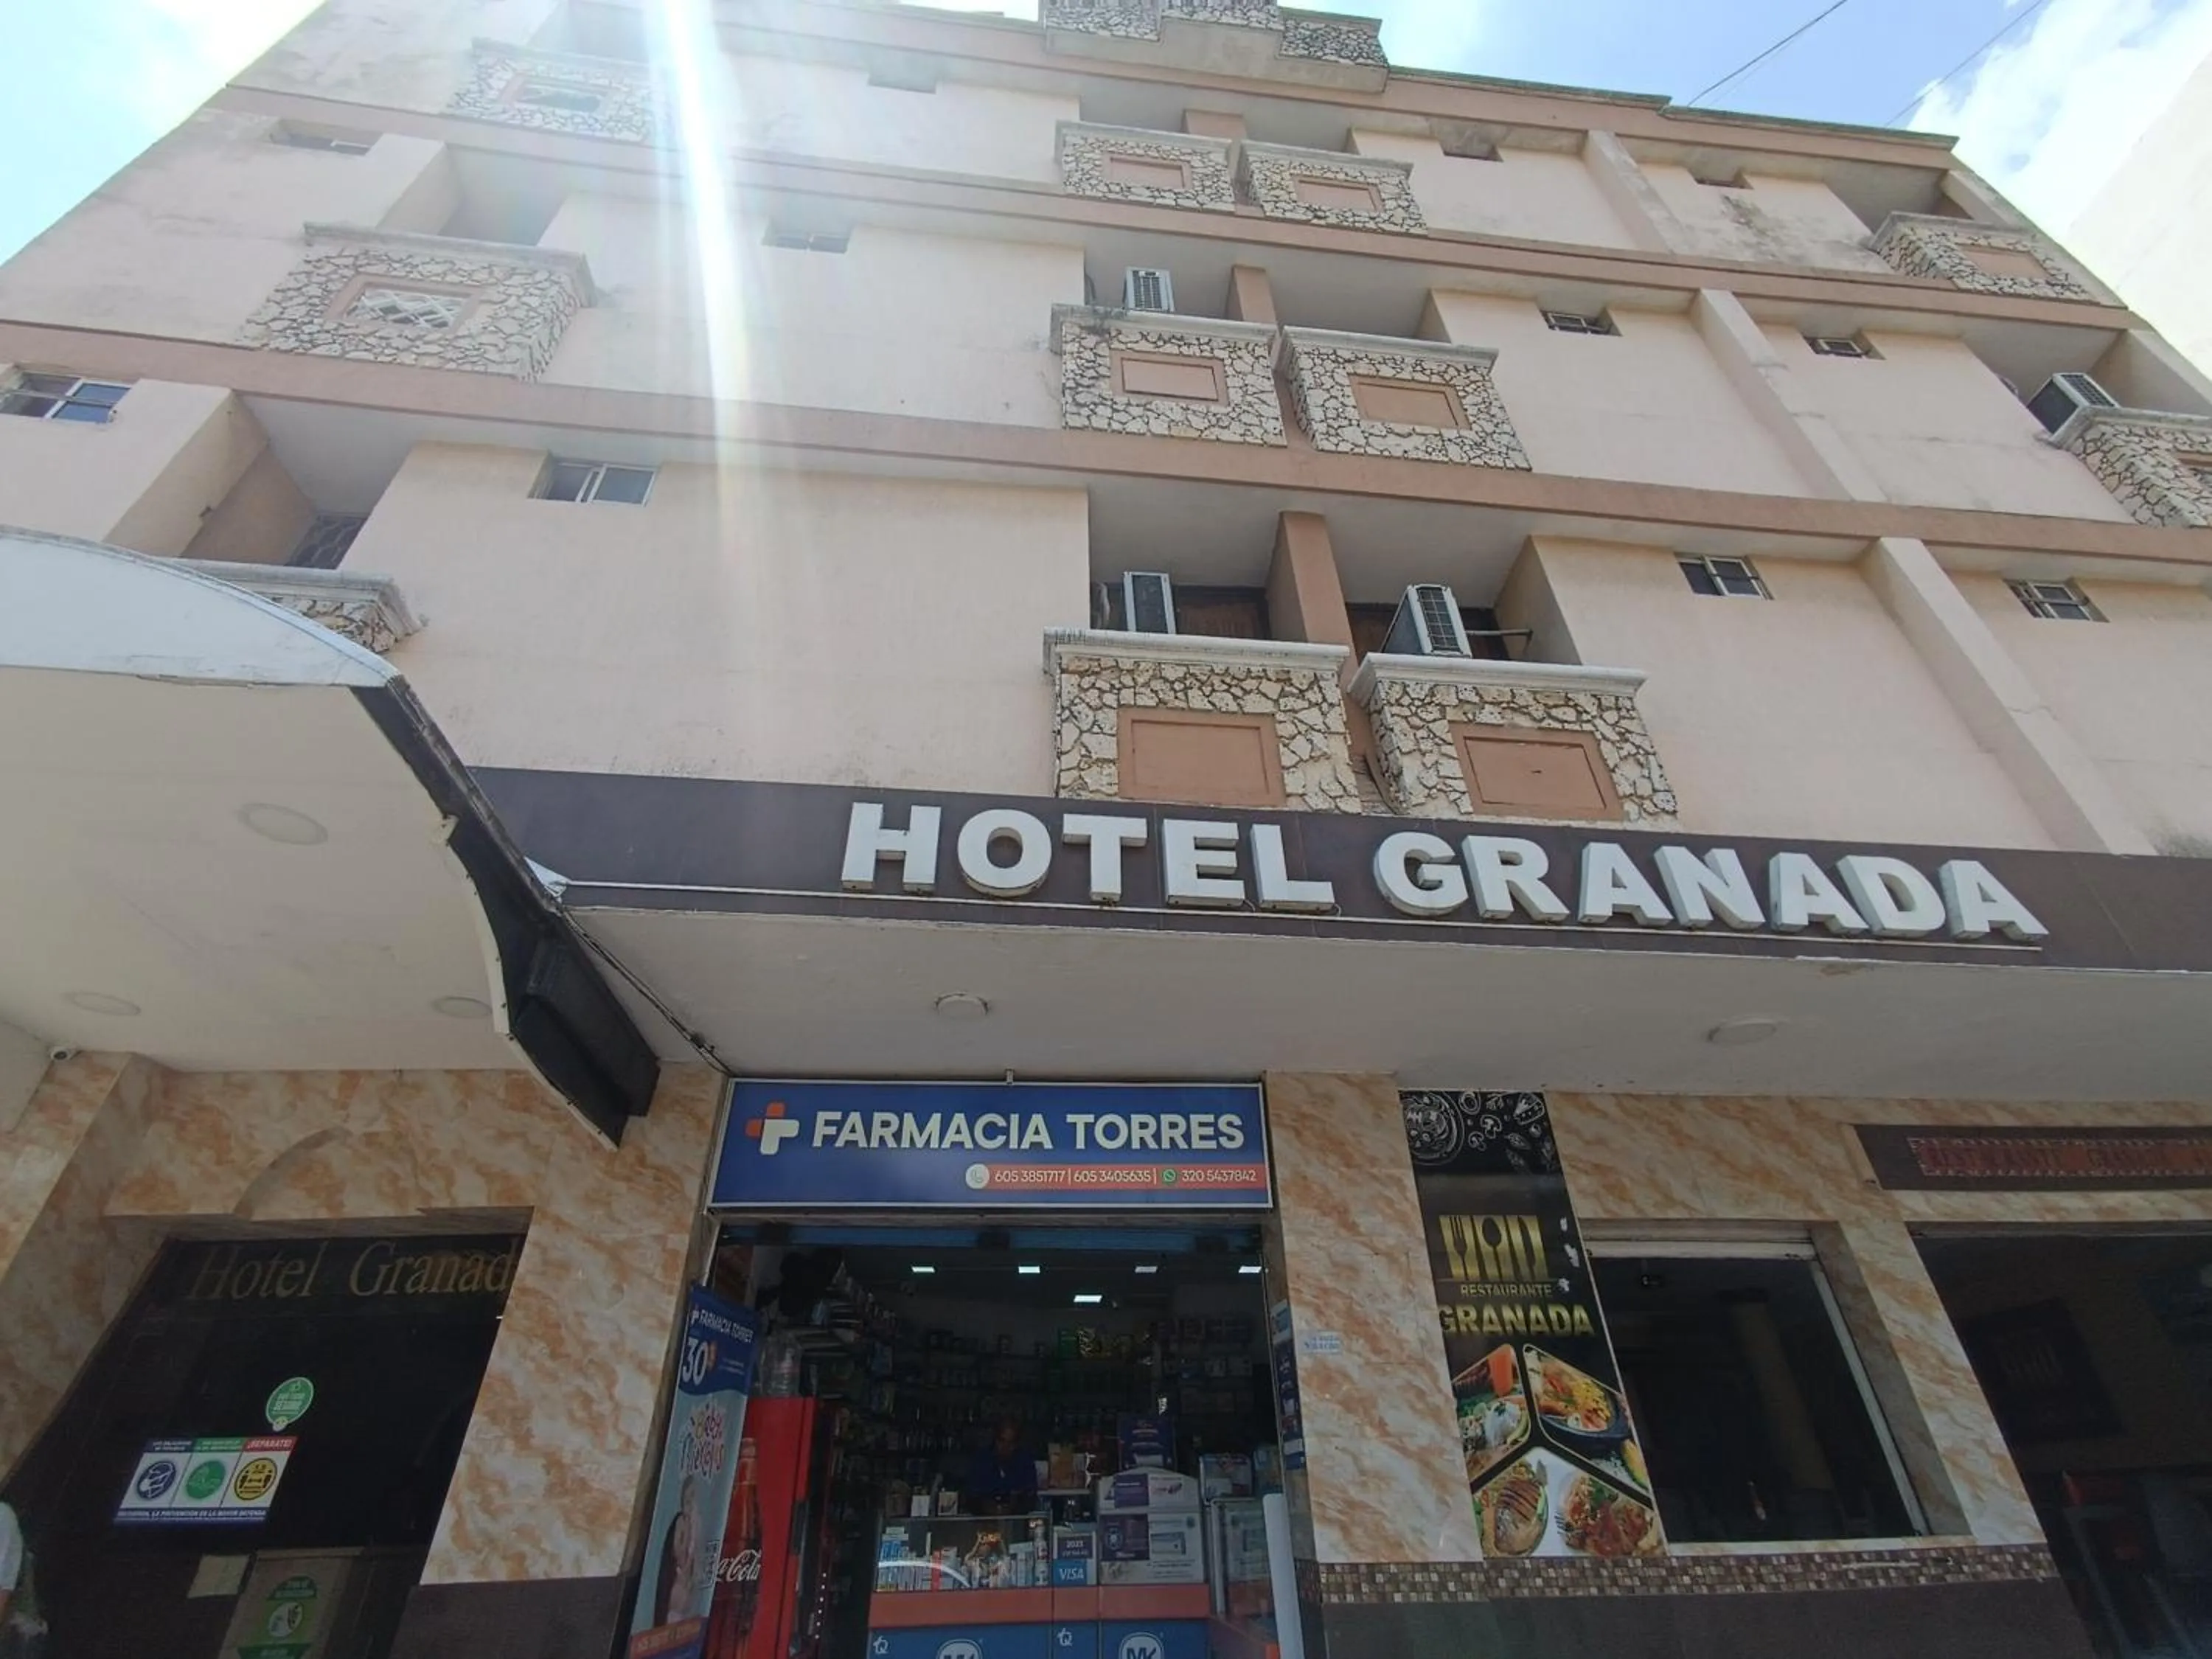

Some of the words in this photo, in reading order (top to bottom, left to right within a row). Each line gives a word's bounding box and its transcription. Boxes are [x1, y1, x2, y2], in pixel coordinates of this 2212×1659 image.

[842, 802, 1335, 914] HOTEL
[1373, 830, 2050, 942] GRANADA
[812, 1110, 1054, 1150] FARMACIA
[1066, 1113, 1245, 1151] TORRES
[994, 1170, 1019, 1183] 605
[1021, 1170, 1065, 1183] 3851717
[1074, 1171, 1098, 1183] 605
[1181, 1169, 1205, 1183] 320
[1207, 1170, 1256, 1183] 5437842
[187, 1240, 330, 1301] Hotel
[349, 1240, 519, 1298] Granad
[1460, 1284, 1552, 1297] RESTAURANTE
[1438, 1304, 1596, 1337] GRANADA
[1059, 1567, 1084, 1581] VISA
